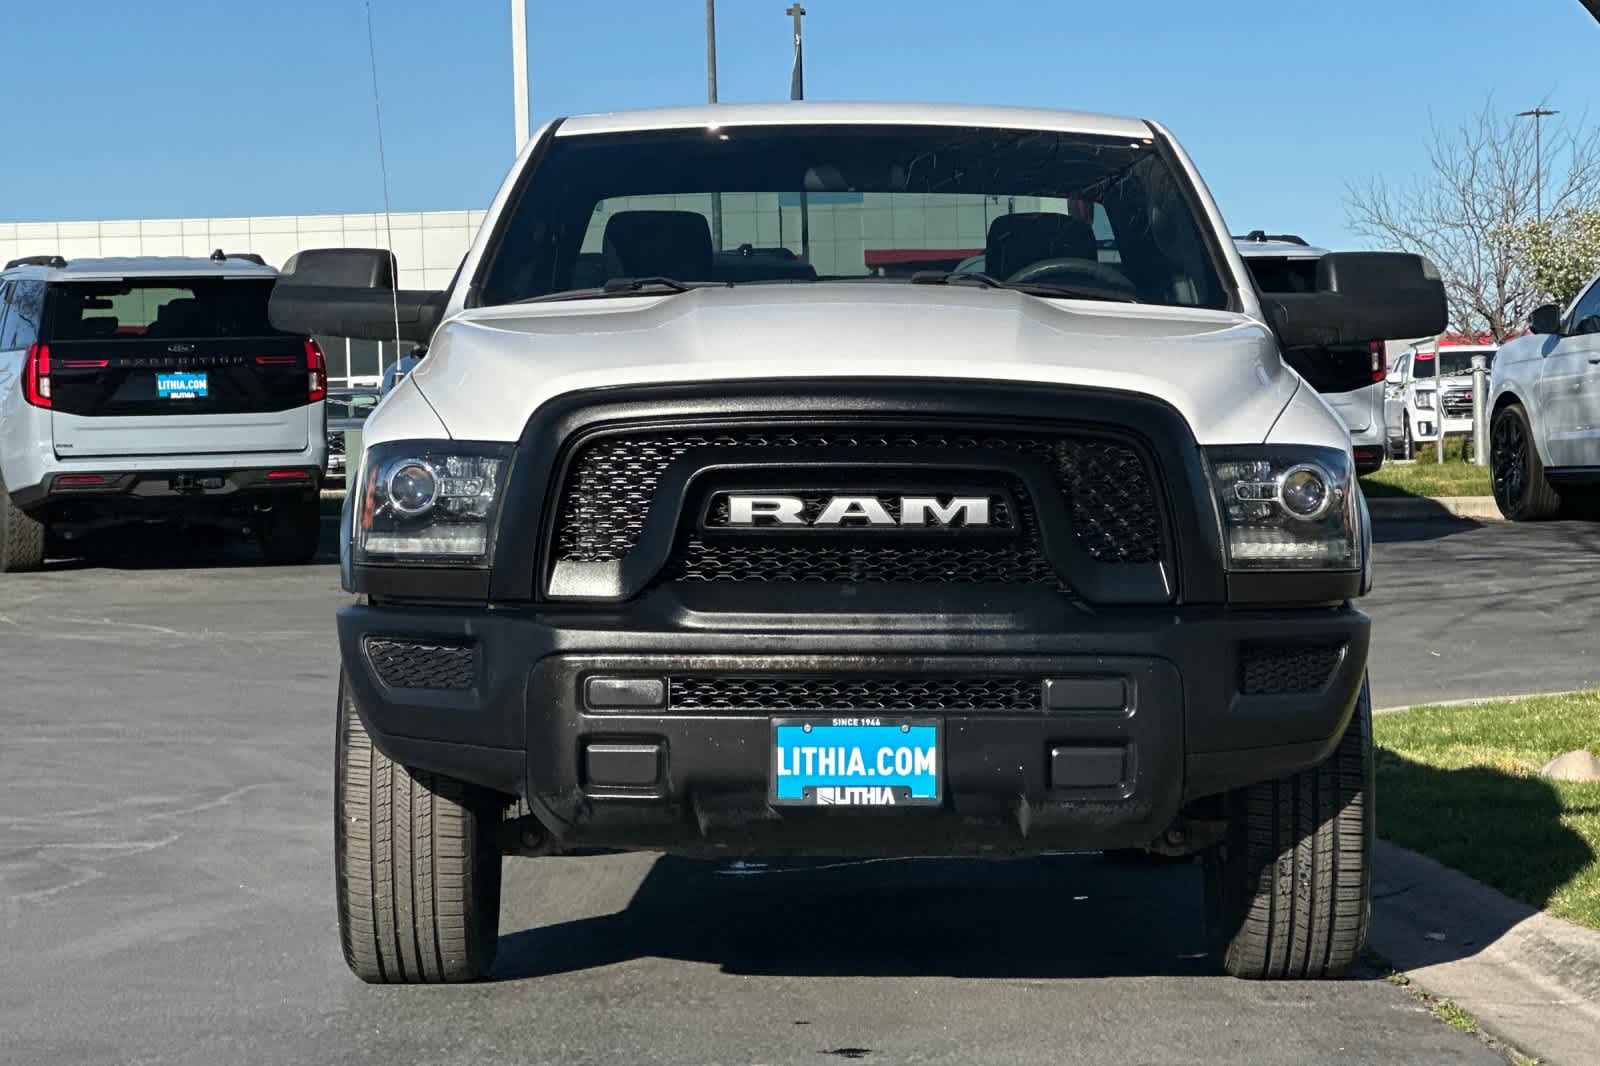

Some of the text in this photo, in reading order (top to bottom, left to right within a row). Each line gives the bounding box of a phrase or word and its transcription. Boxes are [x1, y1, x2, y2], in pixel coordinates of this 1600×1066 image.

[158, 380, 207, 390] LITHIA.COM
[728, 496, 990, 525] RAM
[832, 718, 858, 727] SINCE
[777, 747, 936, 776] LITHIA.COM
[835, 787, 895, 805] LITHIA
